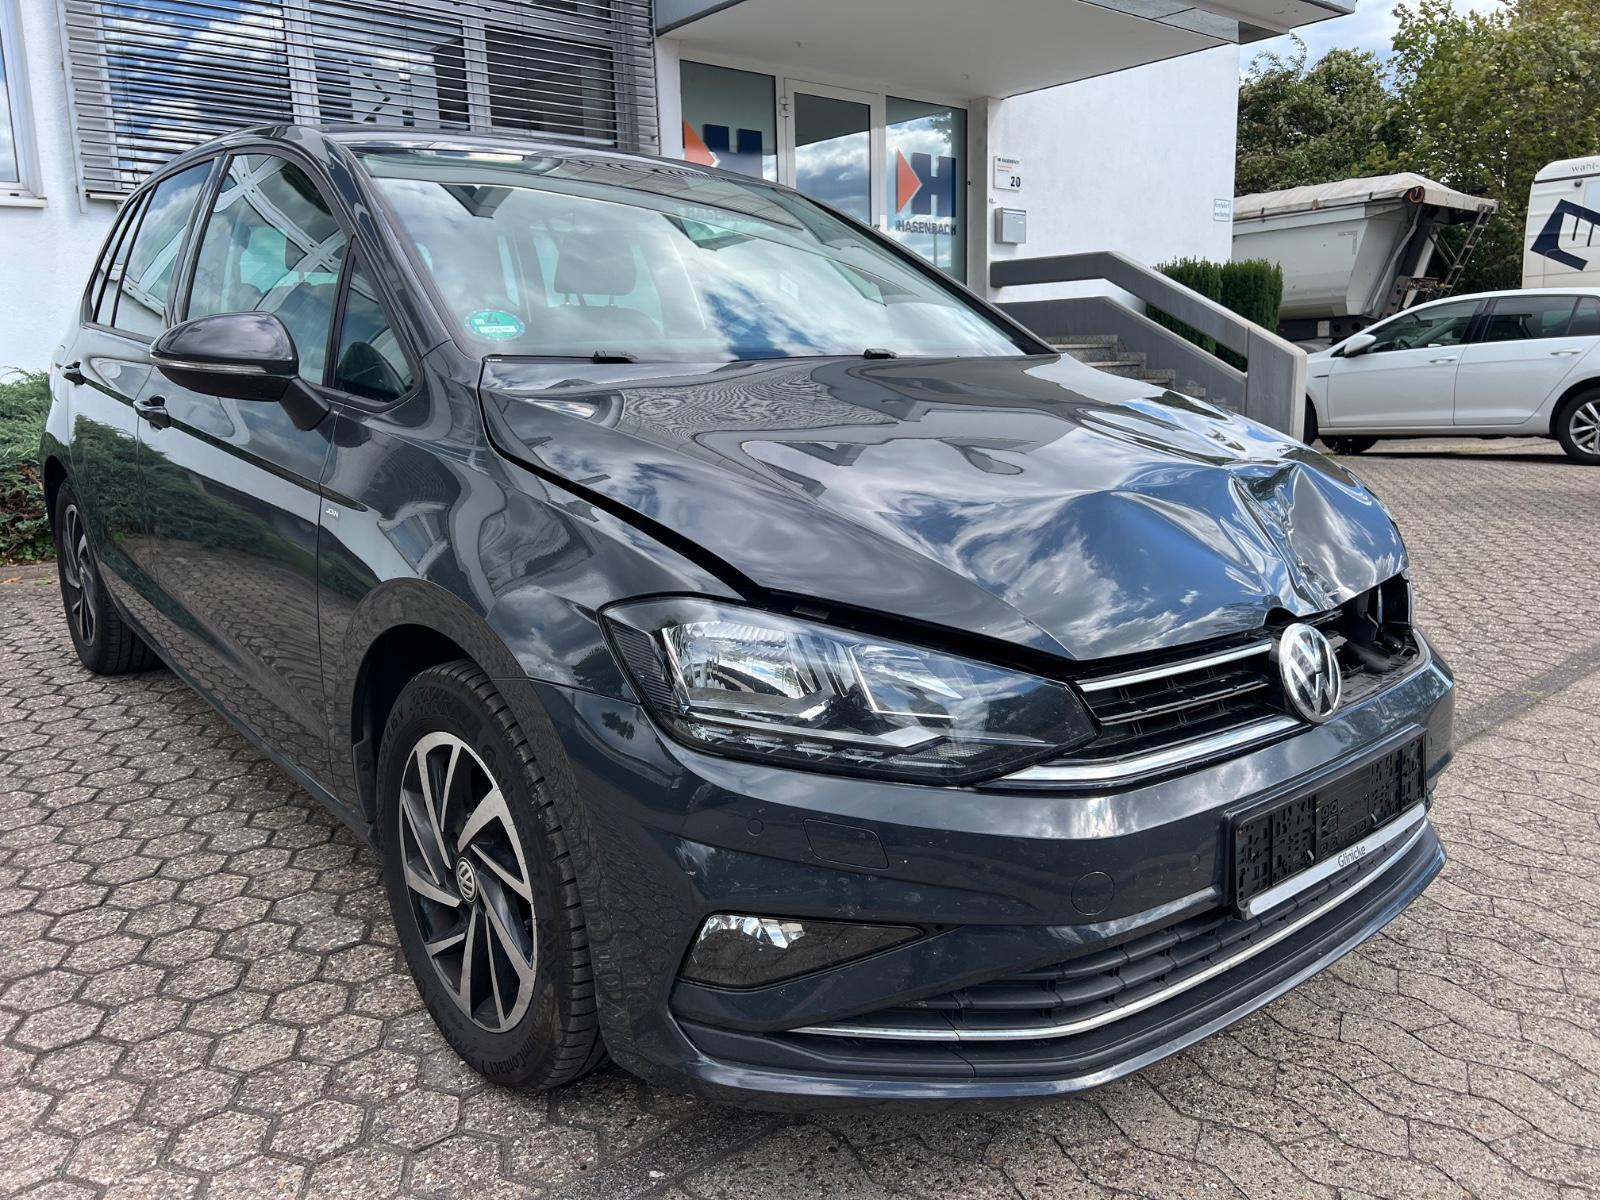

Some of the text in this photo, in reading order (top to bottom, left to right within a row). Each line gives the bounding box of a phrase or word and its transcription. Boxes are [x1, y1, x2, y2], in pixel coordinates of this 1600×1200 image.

[911, 152, 957, 217] H
[1010, 175, 1021, 188] 20
[896, 220, 957, 235] HASENBACH
[1338, 846, 1366, 867] Glinicke
